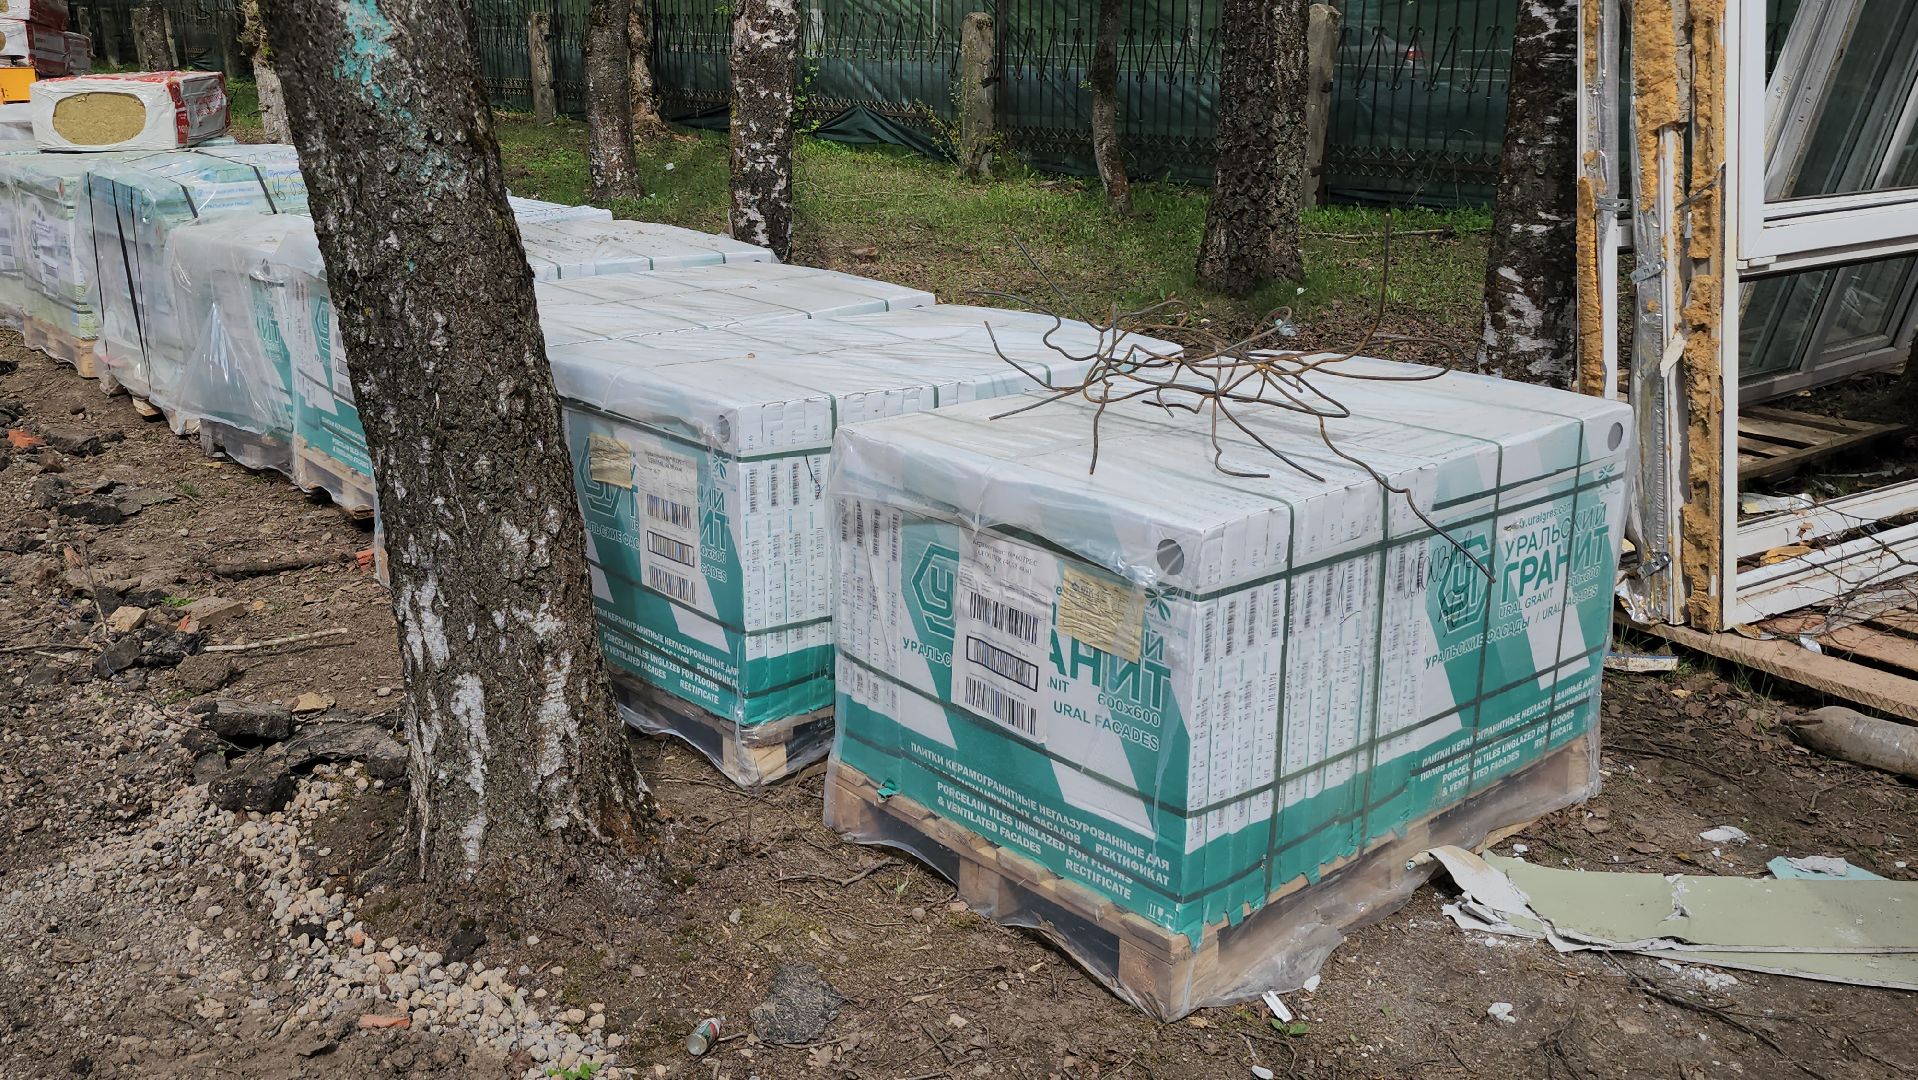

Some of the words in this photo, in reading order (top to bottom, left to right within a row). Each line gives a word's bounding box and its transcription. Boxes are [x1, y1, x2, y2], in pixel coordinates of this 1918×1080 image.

[1505, 501, 1607, 562] УРАЛЬСКИЙ
[1519, 502, 1573, 529] .uralgres.com
[701, 546, 726, 564] 0x600
[701, 564, 727, 583] CADES
[1500, 599, 1523, 619] URAL
[1525, 587, 1554, 609] GRANIT
[1425, 634, 1485, 670] УРАЛЬСКИЕ
[1486, 616, 1531, 643] ФАСАДЫ
[1542, 605, 1562, 620] URAL
[1564, 584, 1598, 609] ACADES
[902, 636, 952, 668] УРАЛЬС
[680, 679, 720, 705] RECTIFICATE
[681, 668, 694, 680] FOR
[694, 674, 720, 693] FLOORS
[1097, 692, 1160, 728] 600x600
[1520, 679, 1583, 719] НЕГЛАЗУРВАННЫЕ
[1053, 699, 1091, 724] URAL
[1094, 713, 1160, 752] FACADES
[1534, 721, 1574, 750] RECIFICATE
[1442, 755, 1482, 784] PORCELIN
[1449, 766, 1490, 793] VENTIATED
[911, 741, 944, 766] ПЛИТКИ
[945, 757, 1038, 811] КЕРАМОГРАНИТНЫЕ
[1039, 803, 1145, 860] НЕГЛАЗУРОВАННЫЕ
[1145, 852, 1170, 872] ДЛЯ
[937, 781, 988, 814] PORCELAIN
[988, 806, 1013, 827] TILES
[1014, 820, 1066, 853] UNGLAZED
[937, 796, 945, 808] &
[946, 800, 999, 833] VENTILATED
[999, 826, 1042, 856] FACADES
[1065, 858, 1132, 901] RECTIFICATE
[1095, 842, 1170, 888] РЕКТИФИКАТ
